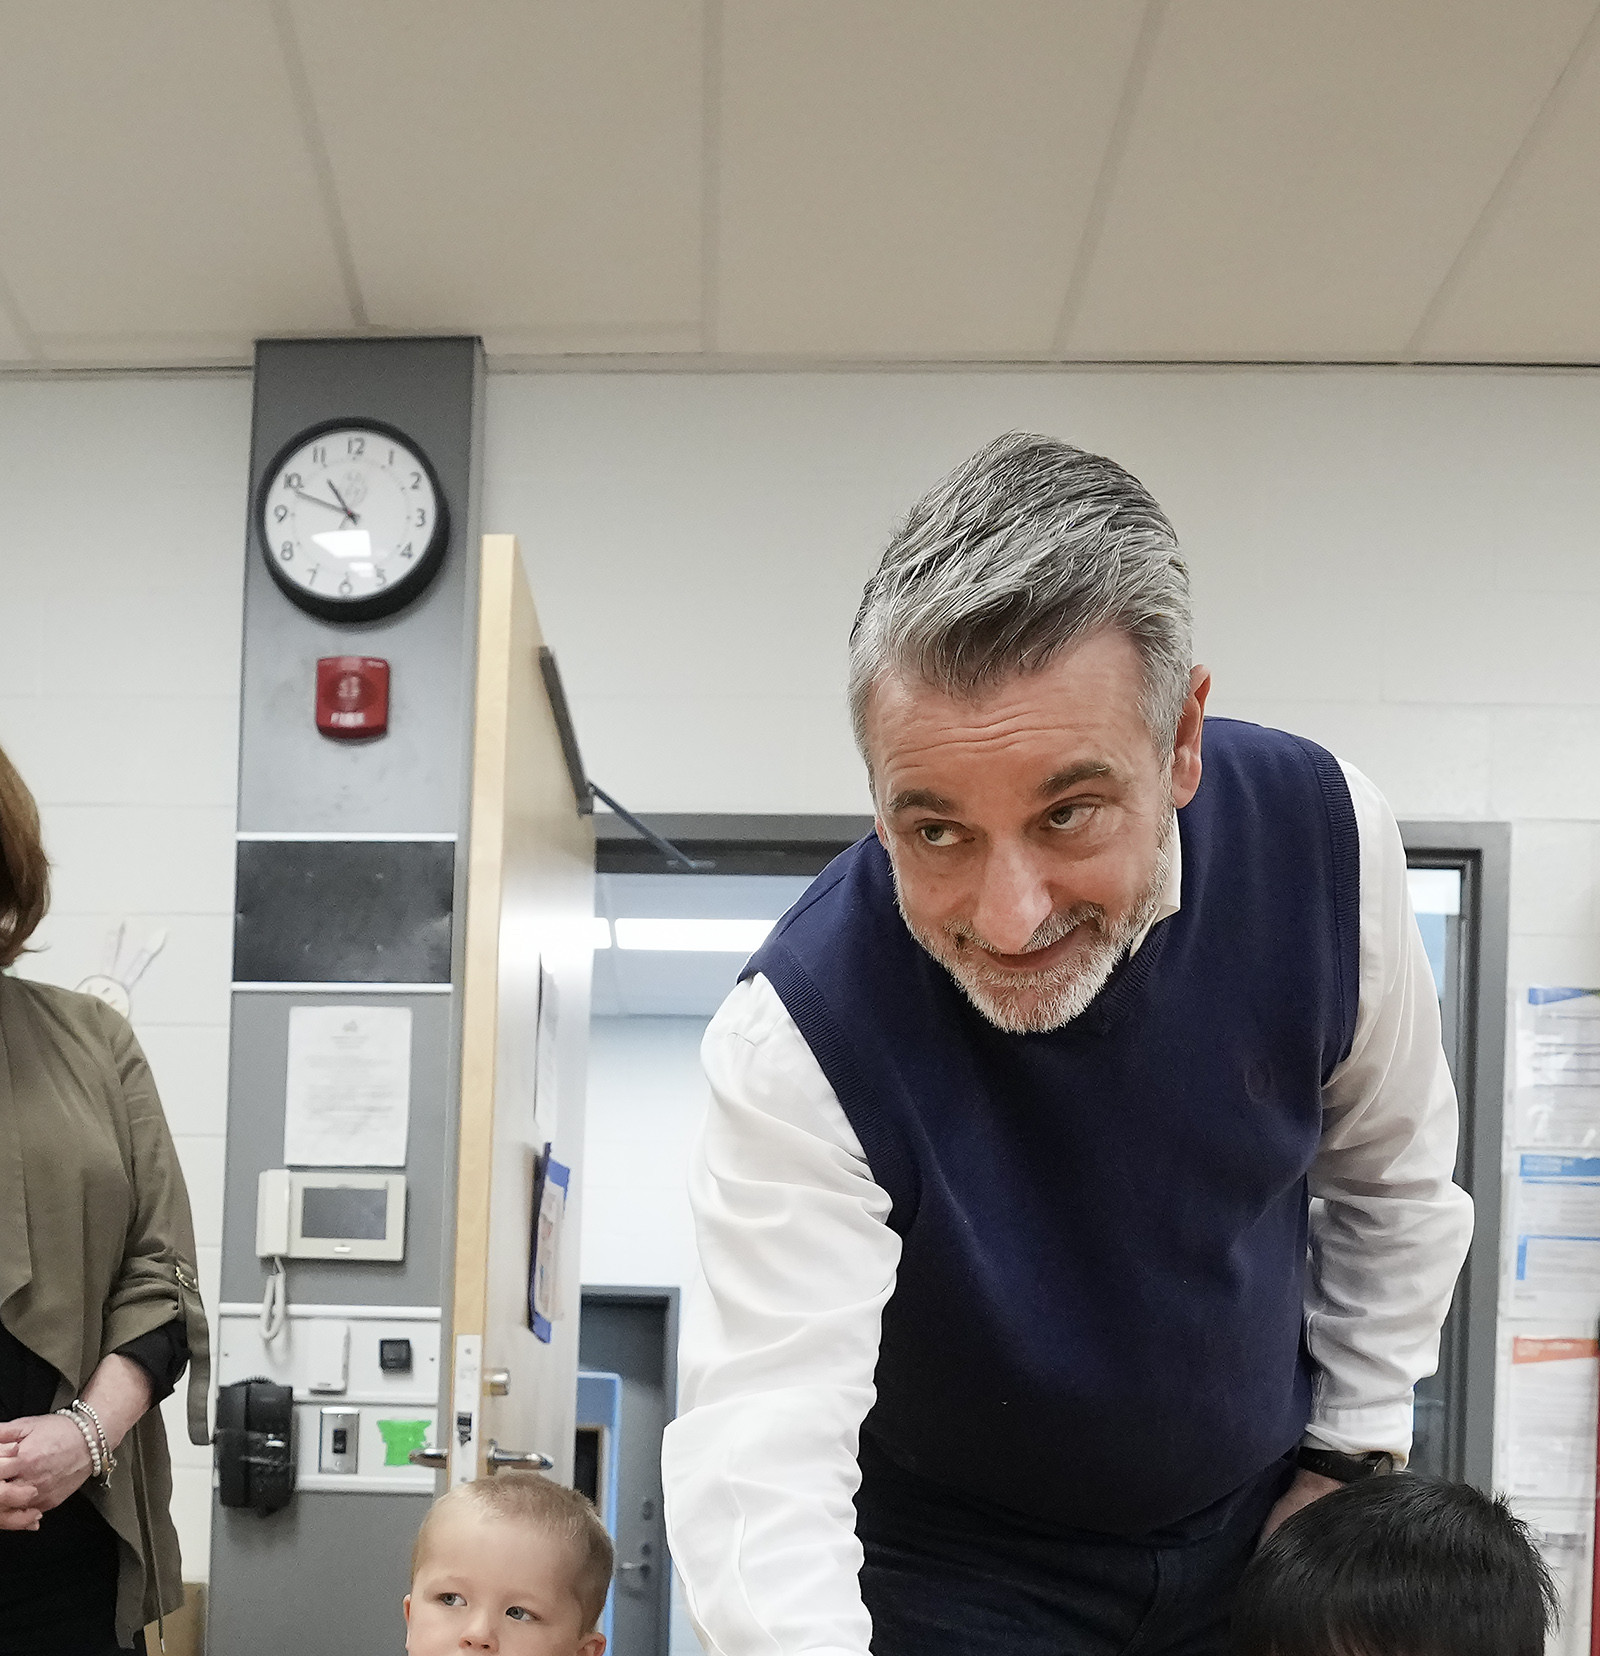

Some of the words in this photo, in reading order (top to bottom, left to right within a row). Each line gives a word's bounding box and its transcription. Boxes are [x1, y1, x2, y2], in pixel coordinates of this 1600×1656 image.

[312, 447, 327, 464] 11
[347, 437, 366, 455] 12
[387, 450, 394, 466] 1
[283, 472, 303, 491] 10
[409, 471, 422, 490] 2
[274, 504, 288, 524] 9
[415, 508, 426, 528] 3
[280, 540, 294, 561] 8
[400, 542, 413, 559] 4
[307, 566, 318, 586] 7
[338, 575, 353, 596] 6
[375, 567, 387, 587] 5
